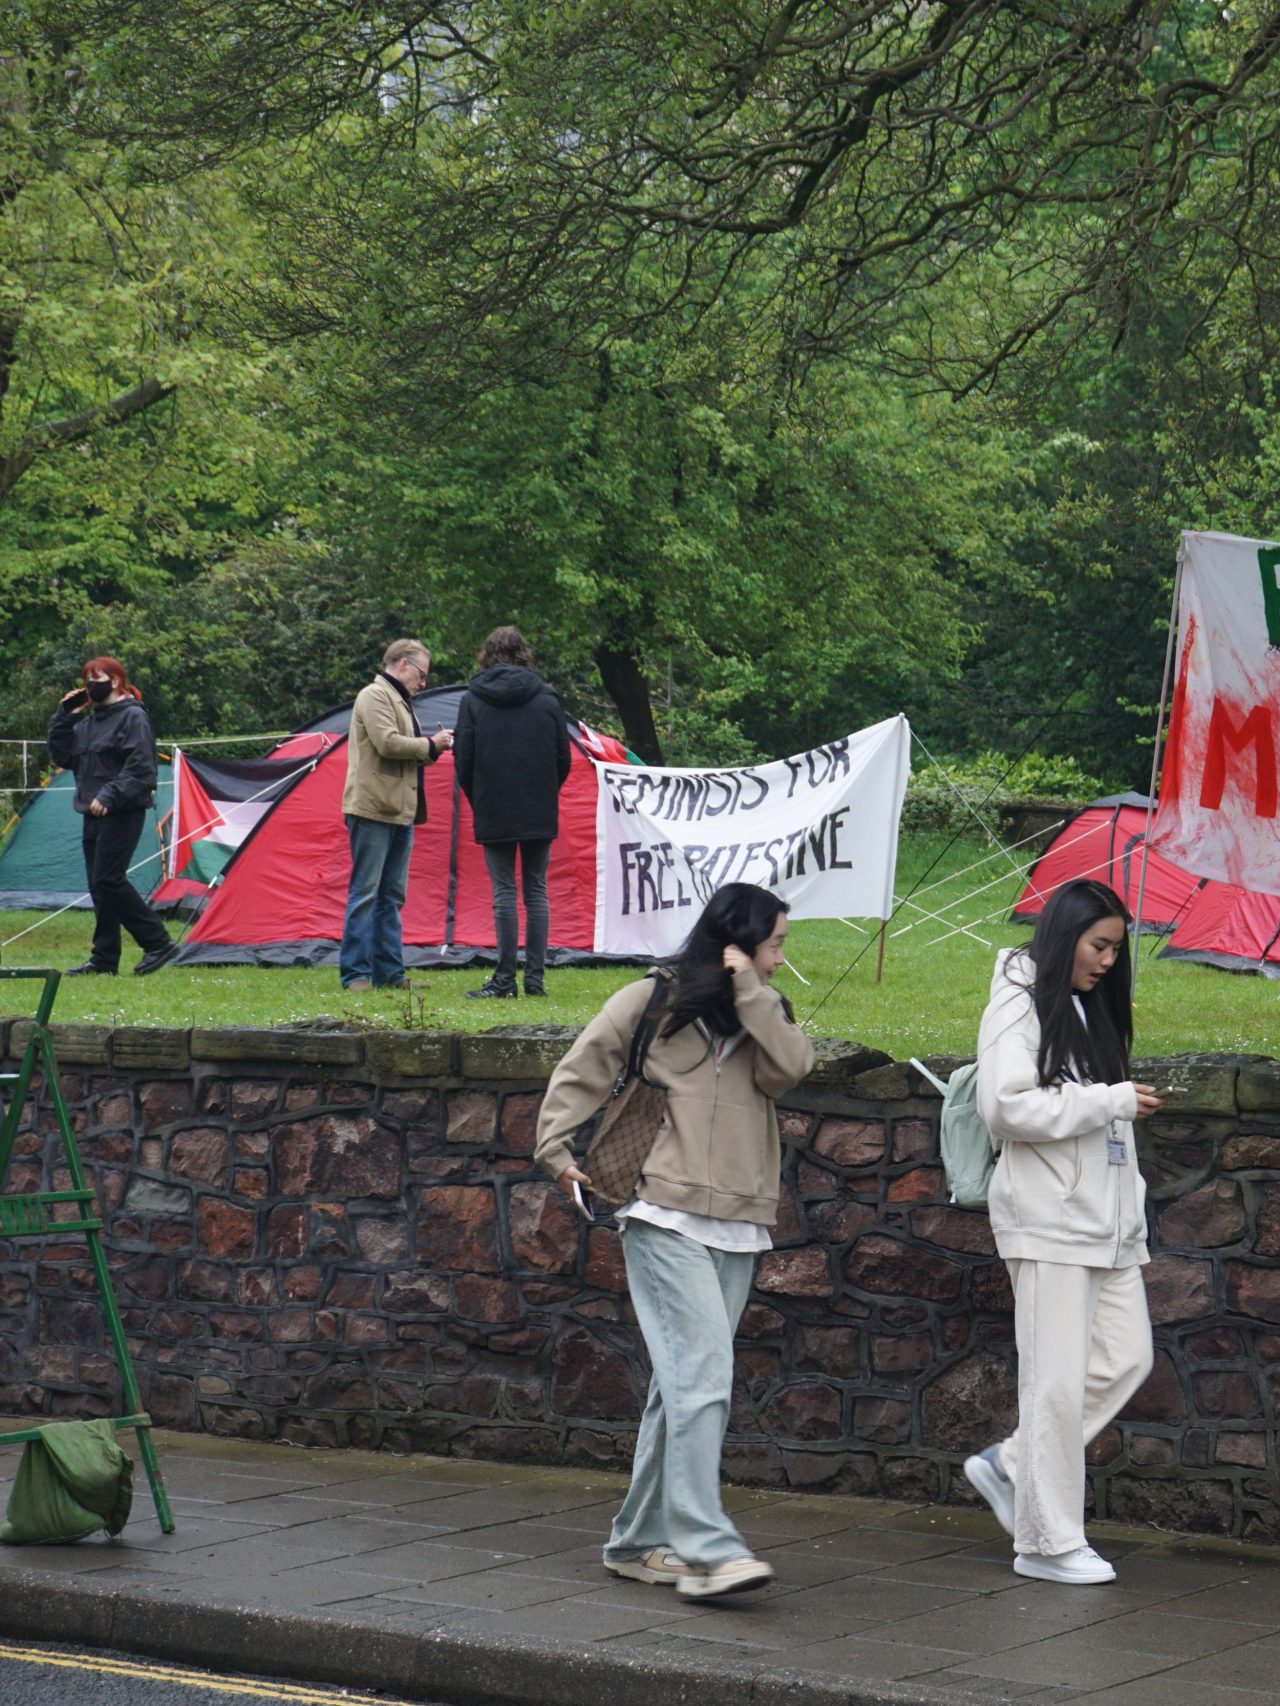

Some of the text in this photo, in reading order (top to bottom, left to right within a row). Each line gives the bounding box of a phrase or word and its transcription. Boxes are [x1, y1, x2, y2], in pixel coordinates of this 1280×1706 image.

[604, 736, 851, 821] FEMINISTS FOR
[619, 806, 852, 915] FREE PALESTINE
